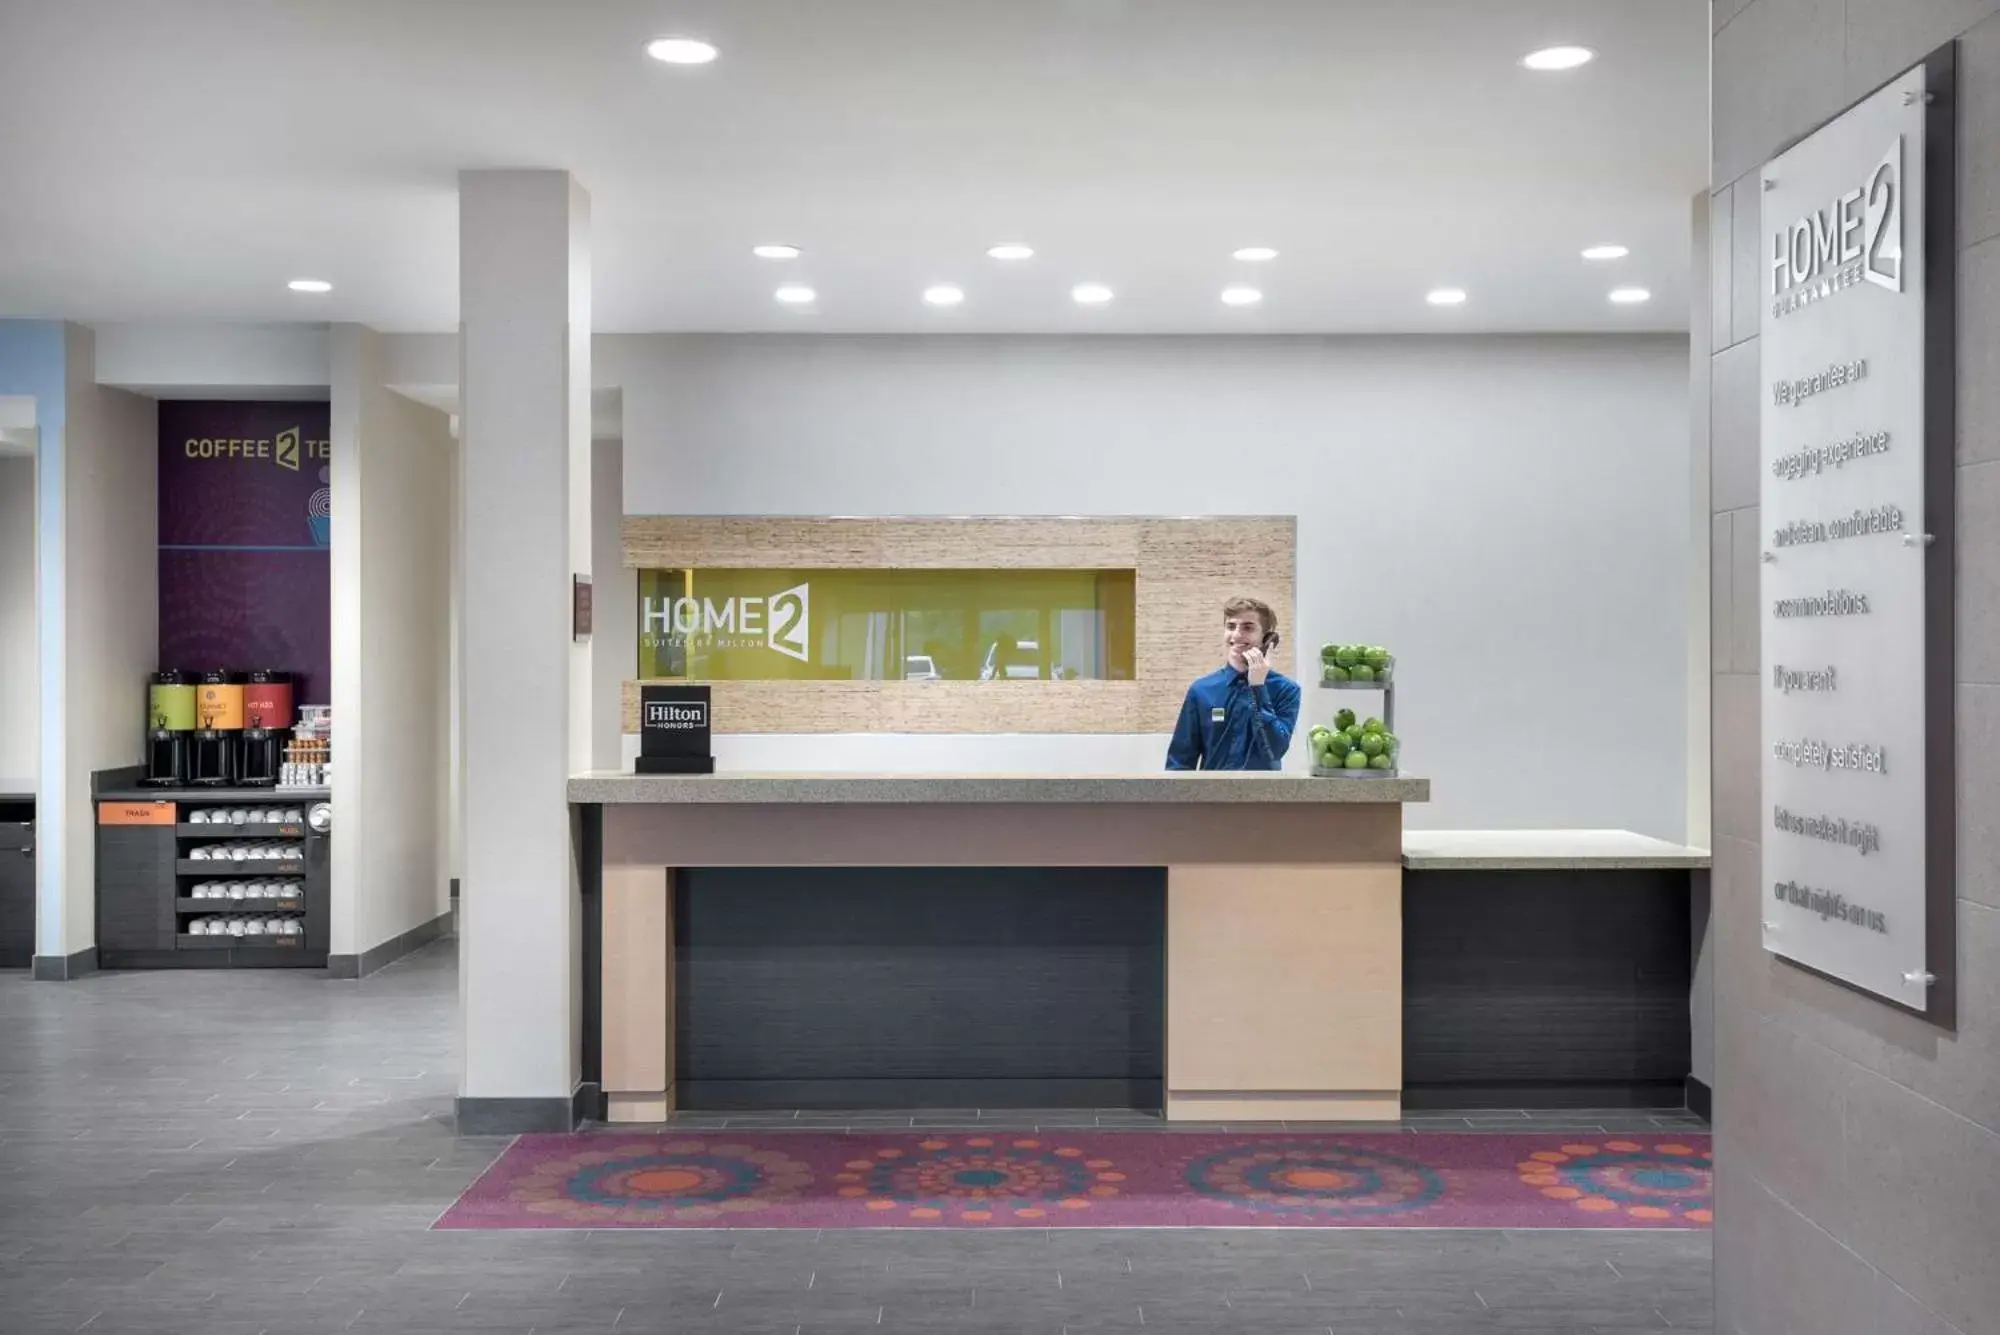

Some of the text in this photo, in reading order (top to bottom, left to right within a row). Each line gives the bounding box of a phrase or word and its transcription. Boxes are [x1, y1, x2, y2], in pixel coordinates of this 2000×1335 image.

[1771, 262, 1864, 319] GUARANTEE
[1771, 359, 1868, 407] We guarantee an
[185, 438, 270, 458] COFFEE
[277, 427, 299, 470] 2
[1770, 431, 1891, 480] engaging experience
[1828, 504, 1902, 540] comfortable
[643, 637, 764, 648] SUITES BY HILTON
[650, 706, 702, 721] Hilton
[1772, 737, 1829, 771] completely
[1774, 881, 1788, 900] or
[1849, 903, 1866, 926] on
